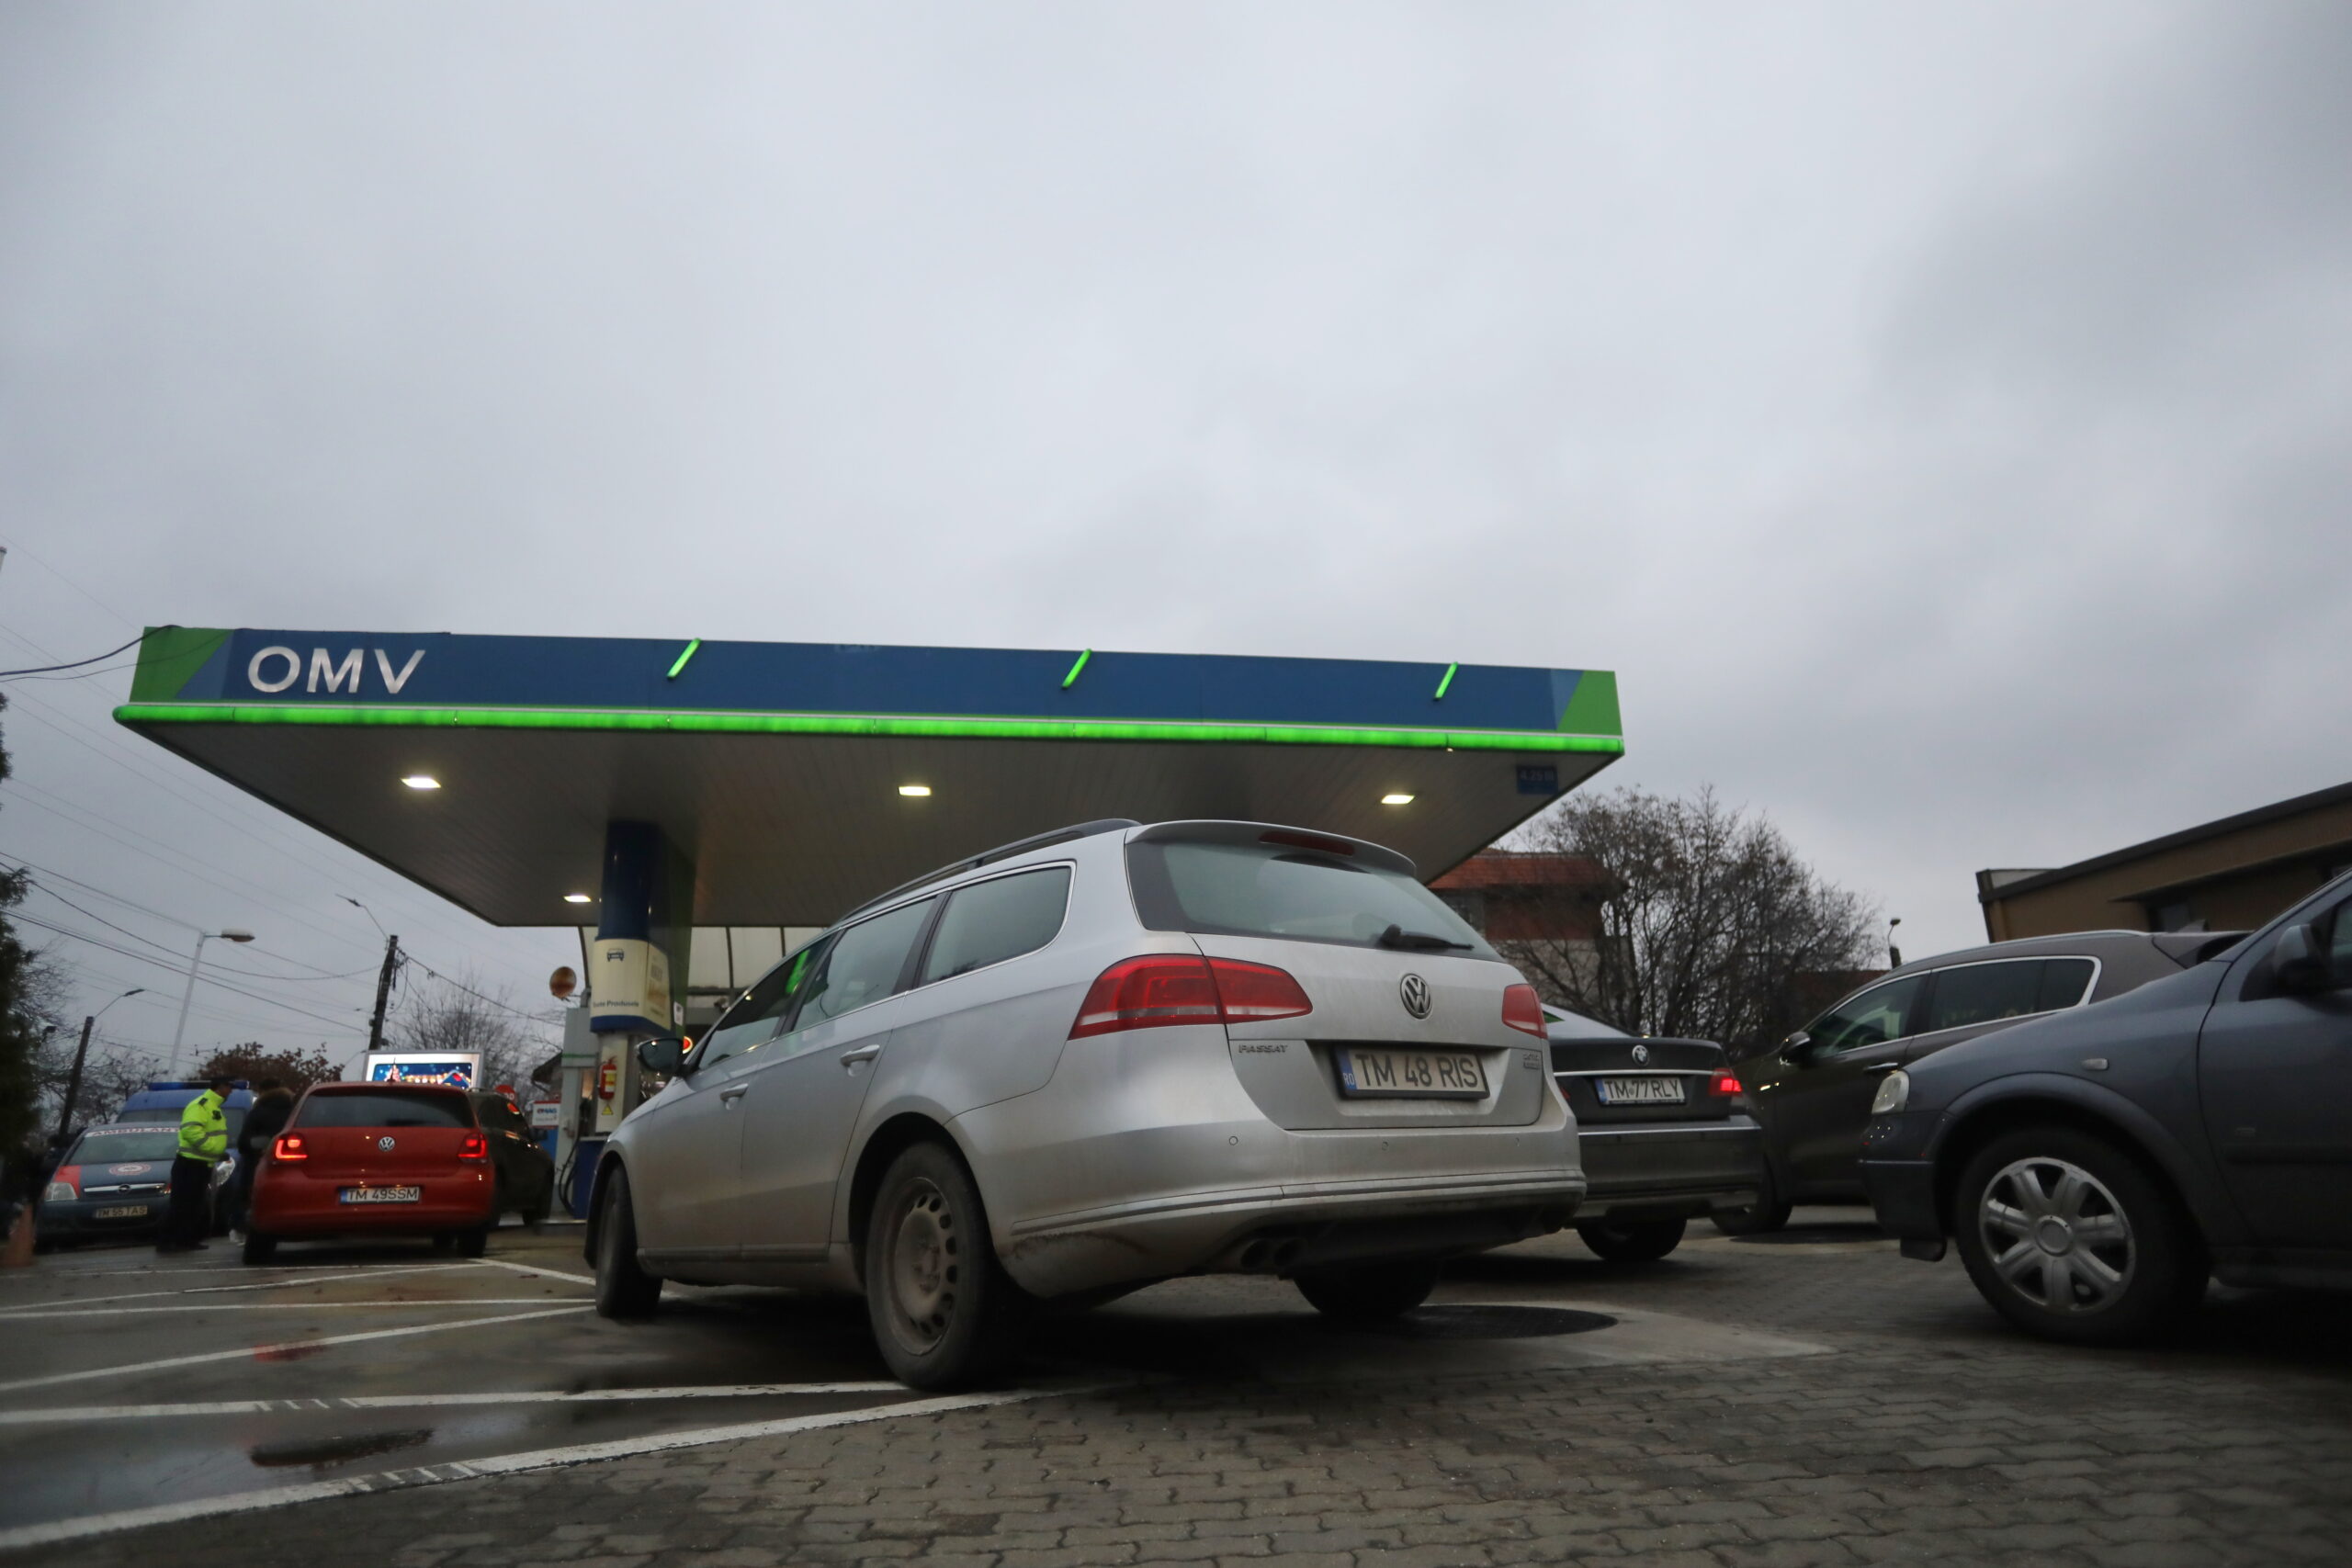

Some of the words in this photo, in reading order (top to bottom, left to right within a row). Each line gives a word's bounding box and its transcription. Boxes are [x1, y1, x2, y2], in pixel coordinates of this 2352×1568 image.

[248, 646, 425, 694] OMV
[1238, 1043, 1288, 1054] PASSAT
[1343, 1073, 1356, 1086] RO
[1354, 1054, 1397, 1087] TM
[1404, 1055, 1432, 1088] 48
[1436, 1056, 1478, 1089] RIS
[1604, 1079, 1630, 1099] TM
[349, 1190, 368, 1201] TM
